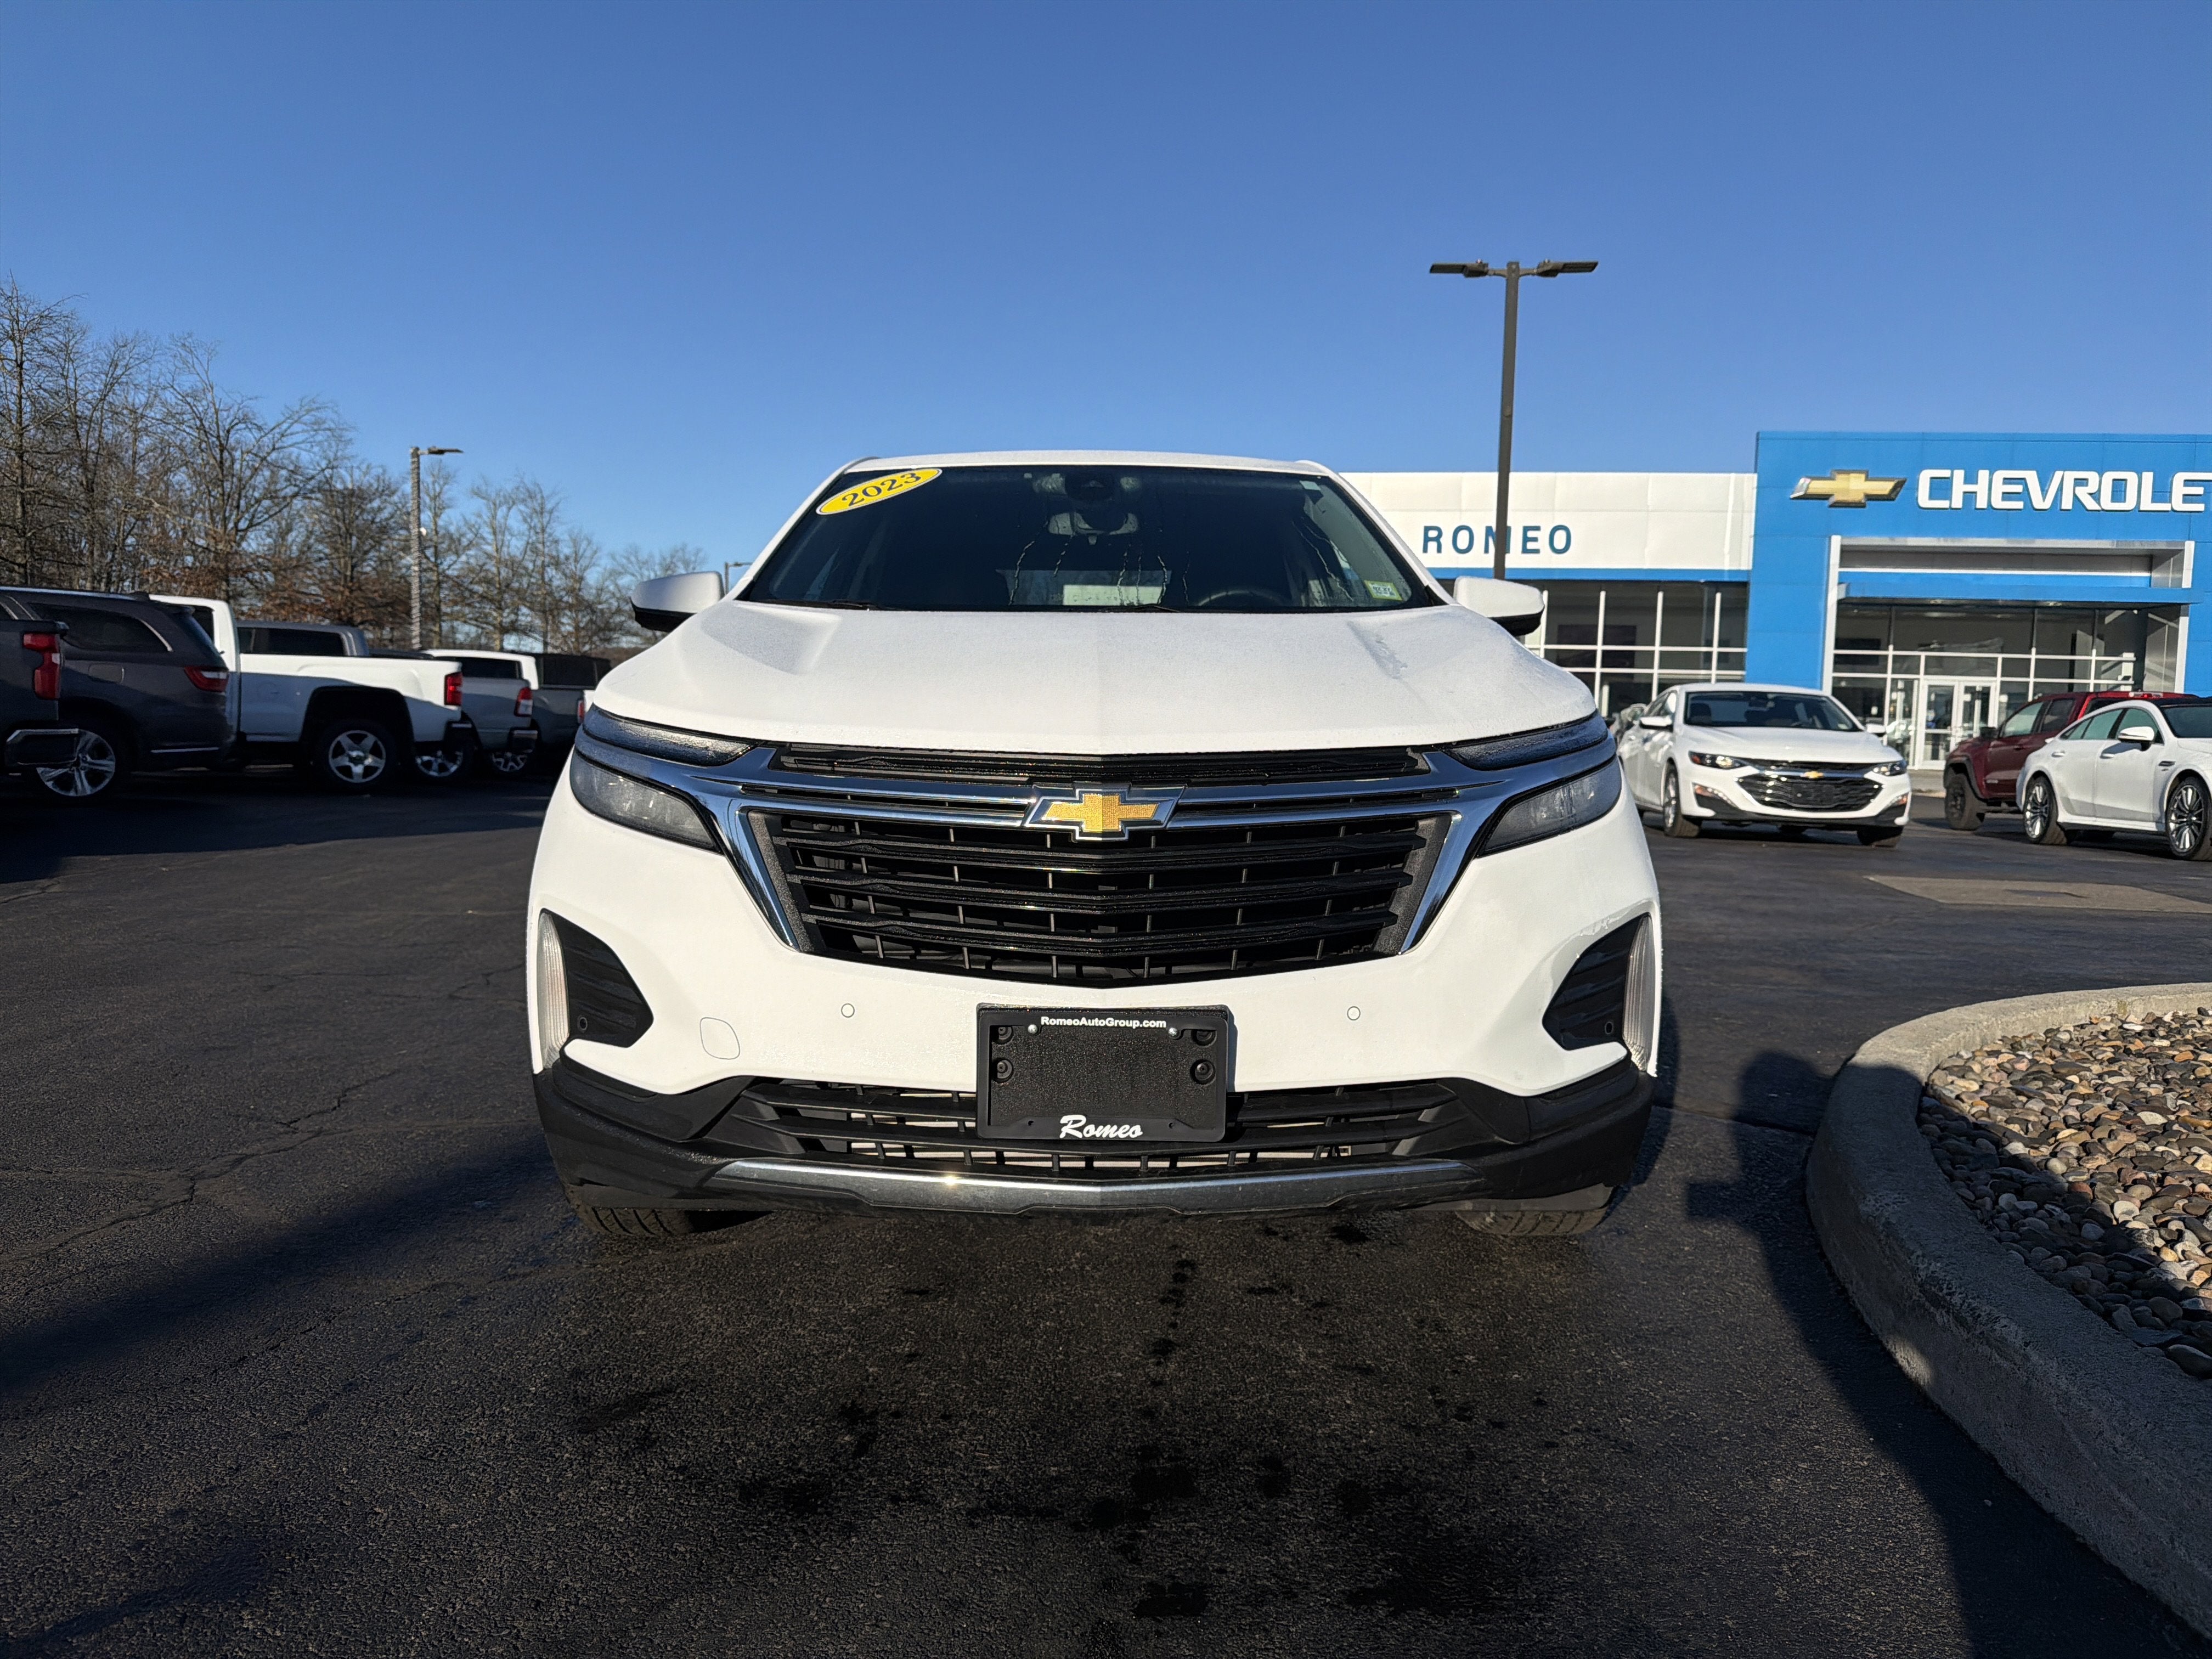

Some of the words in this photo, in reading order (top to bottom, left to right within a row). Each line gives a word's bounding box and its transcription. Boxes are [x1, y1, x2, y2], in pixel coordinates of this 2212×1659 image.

[842, 472, 922, 506] 2023
[1917, 469, 2212, 511] CHEVROLE
[1423, 524, 1571, 554] ROMEO
[1041, 1016, 1167, 1029] RomeoAutoGroup.com
[1059, 1114, 1143, 1139] Romeo
